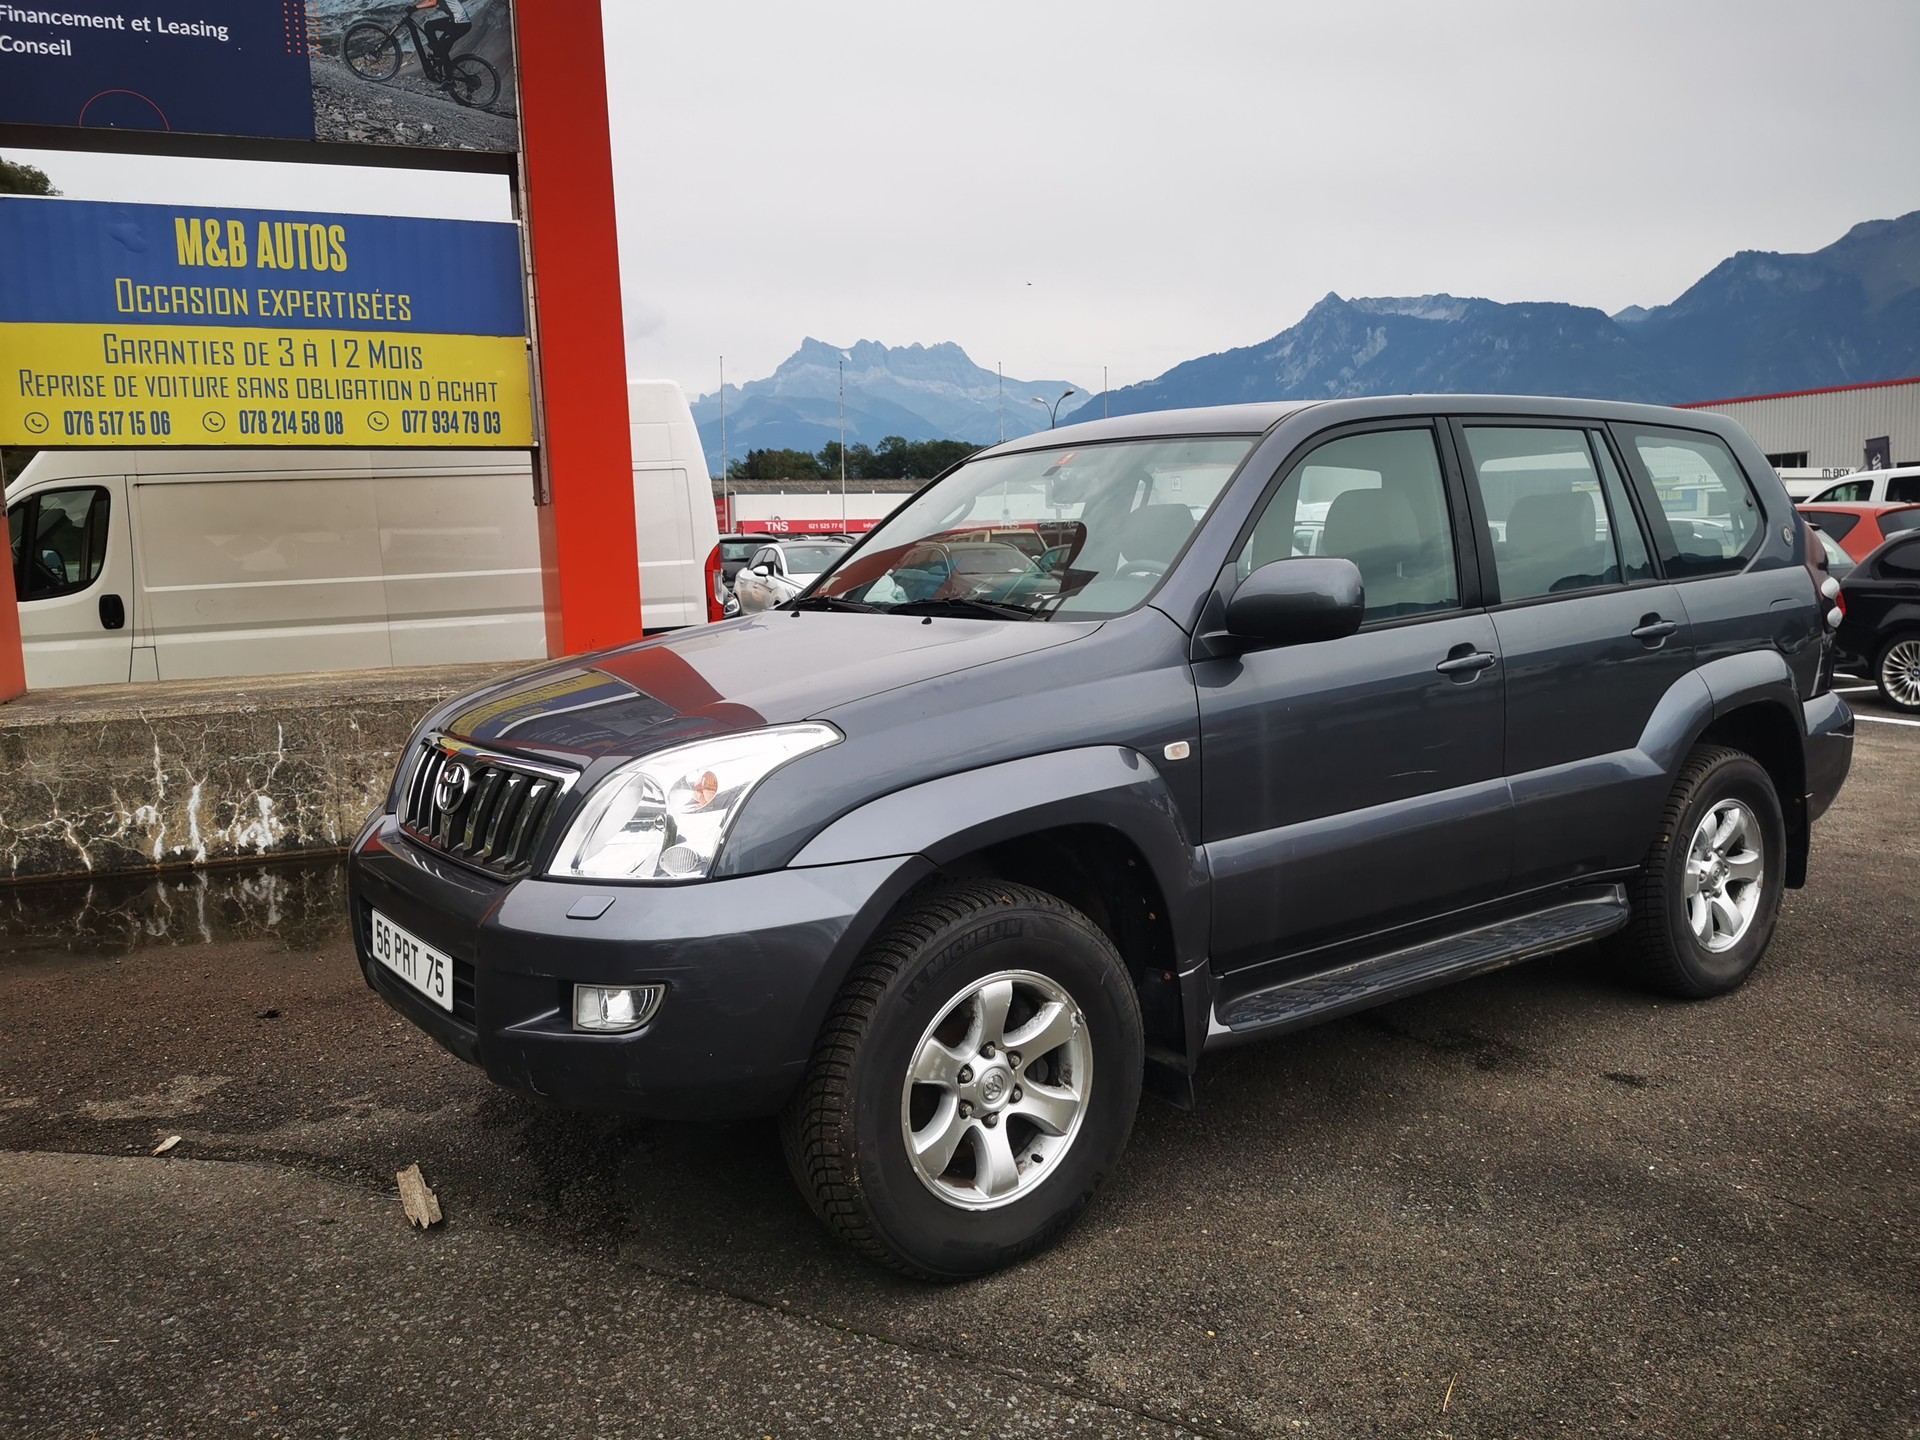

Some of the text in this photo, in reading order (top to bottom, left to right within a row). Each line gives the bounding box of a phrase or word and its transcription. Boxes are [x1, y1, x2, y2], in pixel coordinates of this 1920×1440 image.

[0, 4, 229, 41] Financement et Leasing
[0, 34, 73, 57] Conseil
[174, 217, 348, 273] M&B AUTOS
[115, 277, 412, 321] OCCASION EXPERTISÉES
[103, 333, 236, 366] GARANTIES
[244, 341, 271, 367] DE
[278, 337, 295, 367] 3
[367, 339, 424, 370] MOIS
[18, 369, 107, 398] REPRISE
[114, 375, 139, 398] DE
[144, 375, 231, 399] VOITURE
[236, 377, 290, 400] SANS
[295, 378, 413, 401] OBLIGATION
[63, 410, 171, 436] 076 517 15 06
[238, 409, 344, 435] 078 214 58 08
[401, 409, 502, 435] 077 934 79 03
[765, 521, 790, 532] TNS
[376, 918, 445, 998] 56 PRT 75
[925, 918, 1022, 981] MICHELIN
